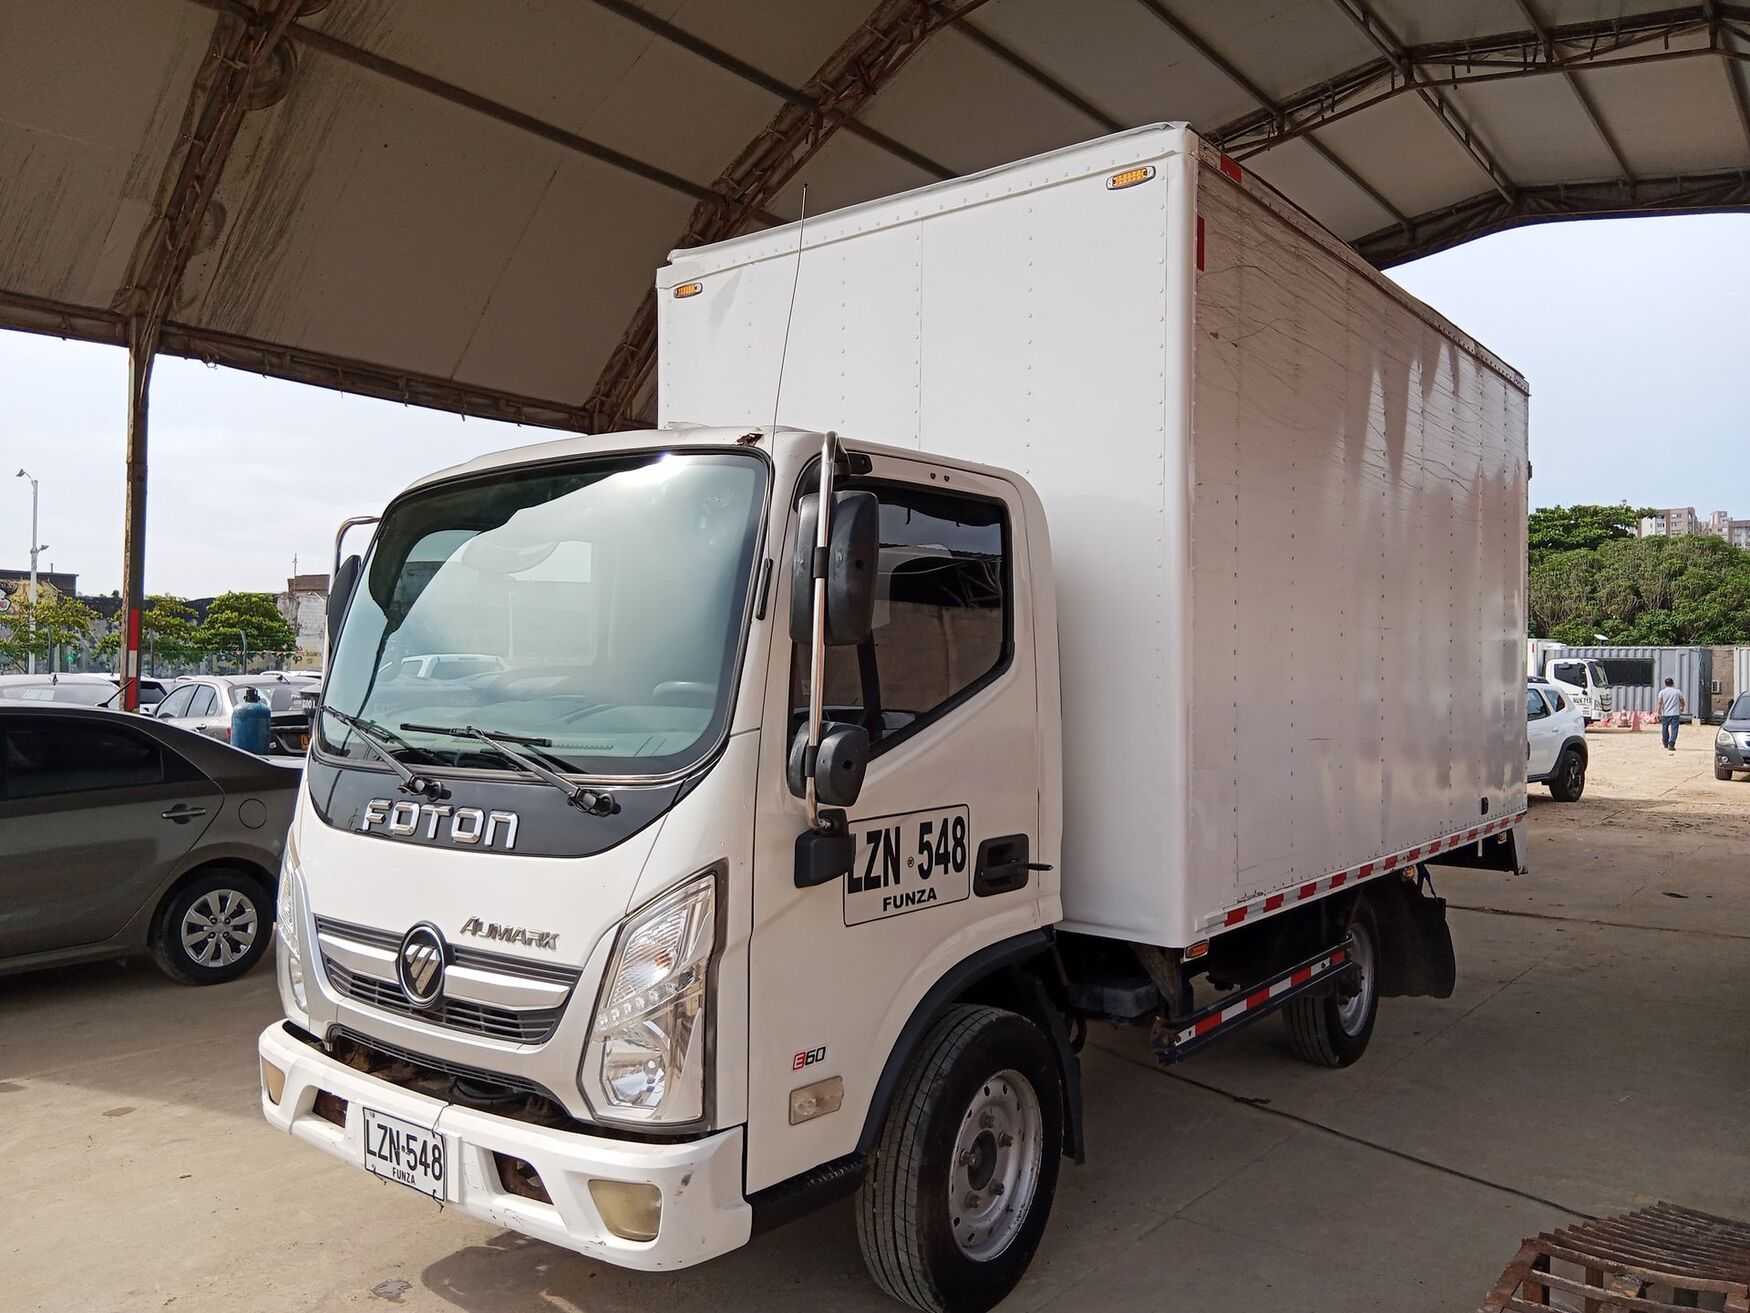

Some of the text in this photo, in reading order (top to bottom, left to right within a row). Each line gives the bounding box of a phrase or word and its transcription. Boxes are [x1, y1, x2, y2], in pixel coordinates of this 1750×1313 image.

[362, 798, 519, 849] FOTON
[917, 815, 967, 881] 548
[882, 887, 938, 912] FUNZA
[459, 915, 560, 951] AUMARK
[392, 1167, 416, 1186] FUNZA
